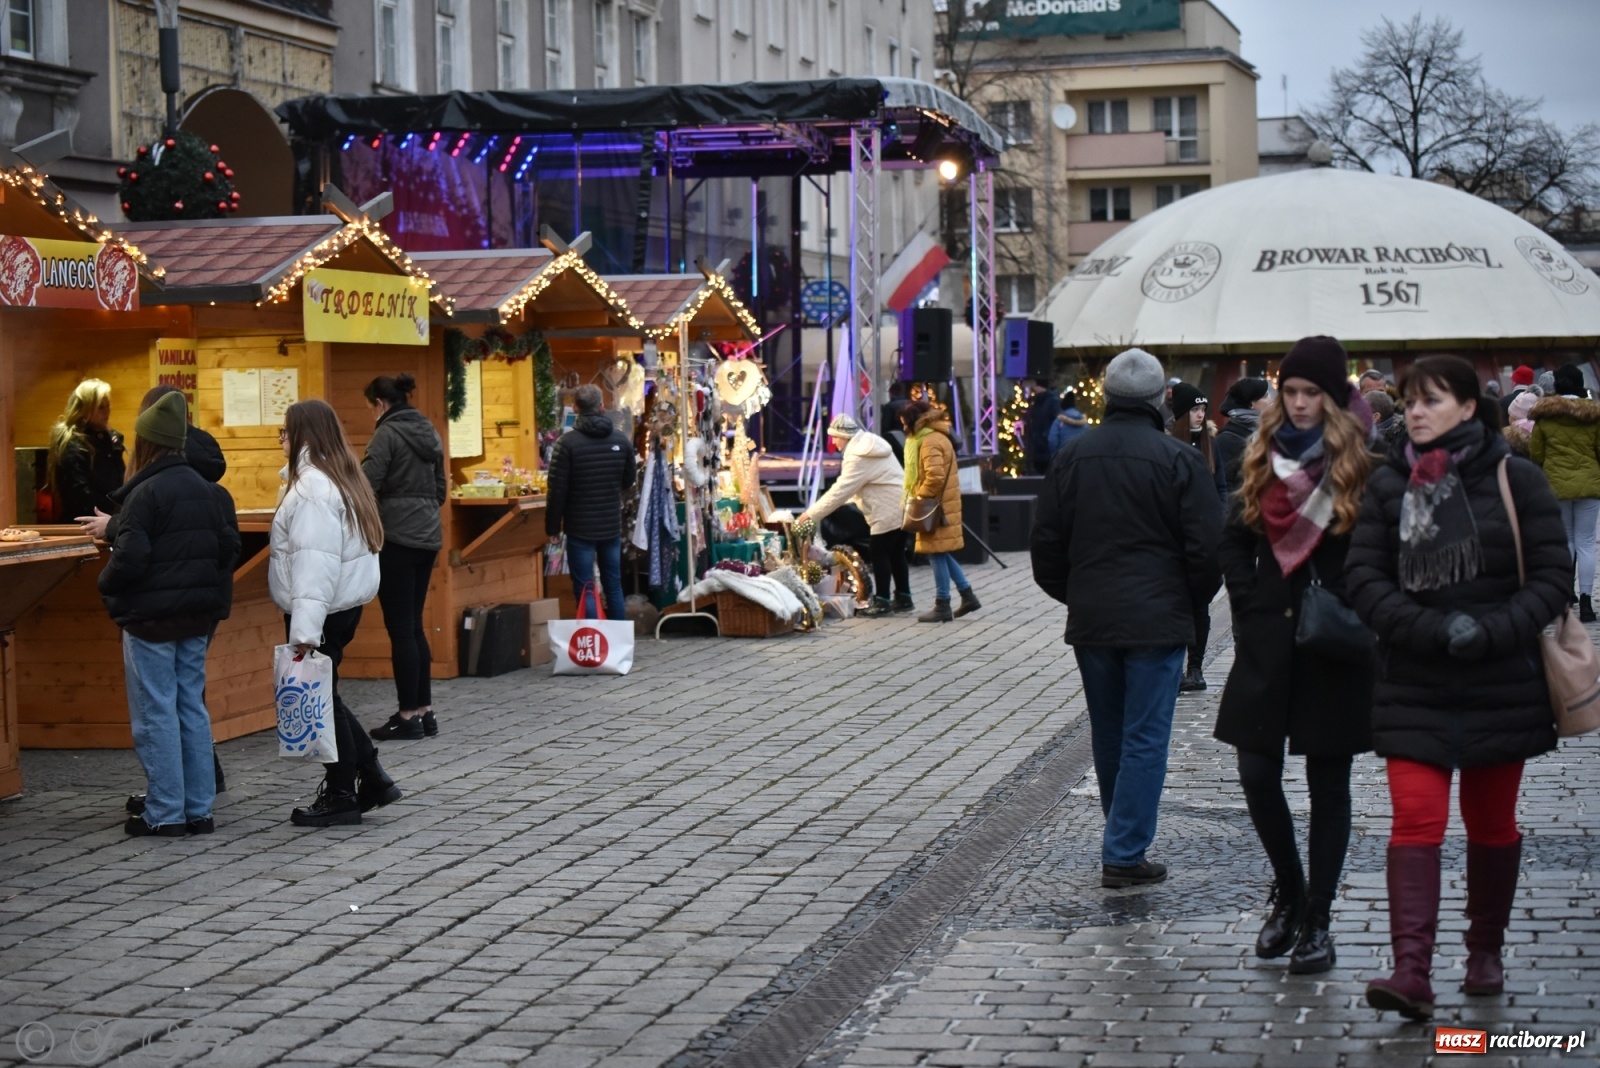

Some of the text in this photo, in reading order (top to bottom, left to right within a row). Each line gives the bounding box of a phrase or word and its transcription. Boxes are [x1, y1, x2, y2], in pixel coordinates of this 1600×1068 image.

[42, 255, 95, 289] LANGOŠ
[1252, 247, 1371, 272] BROWAR
[1373, 242, 1504, 268] RACIBÓRZ
[321, 286, 418, 323] TRDELNÍK
[1359, 280, 1420, 306] 1567
[158, 349, 197, 365] VANILKA
